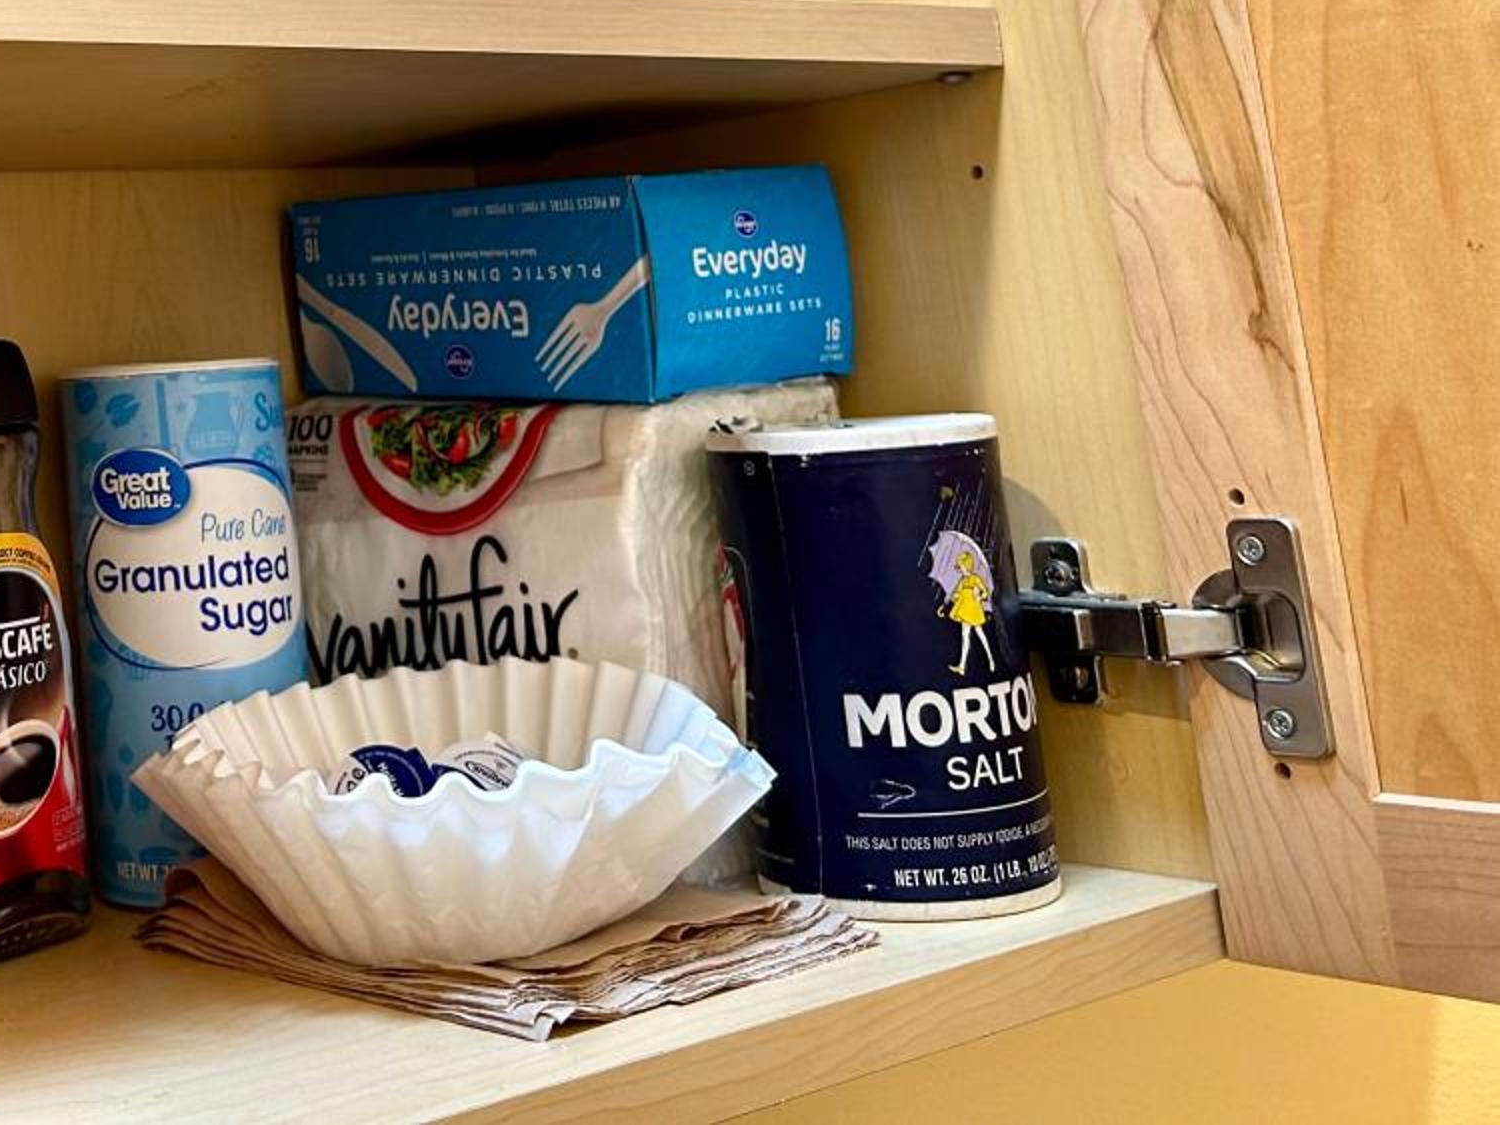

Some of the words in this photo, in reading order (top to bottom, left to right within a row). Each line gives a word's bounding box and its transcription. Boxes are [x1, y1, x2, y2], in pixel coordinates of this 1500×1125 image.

[513, 262, 602, 281] PLASTIC
[692, 239, 806, 279] Everyday
[327, 272, 367, 288] SETS
[377, 267, 501, 286] DINNERWARE
[725, 283, 785, 300] PLASTIC
[388, 295, 529, 338] Everyday
[687, 301, 783, 324] DINNERWARE
[789, 297, 822, 313] SETS
[825, 317, 841, 343] 16
[287, 415, 333, 443] 100
[100, 465, 171, 494] Great
[116, 490, 173, 511] Value
[200, 512, 245, 544] Pure
[251, 508, 287, 537] Cane
[94, 546, 290, 593] Granulated
[199, 595, 293, 636] Sugar
[946, 746, 1024, 791] SALT
[845, 834, 871, 851] THIS
[871, 836, 898, 852] SALT
[901, 836, 932, 851] DOES
[933, 835, 955, 851] NOT
[957, 831, 995, 850] SUPPLY
[893, 869, 920, 887] NET
[923, 868, 949, 887] WT.
[952, 867, 967, 885] 26
